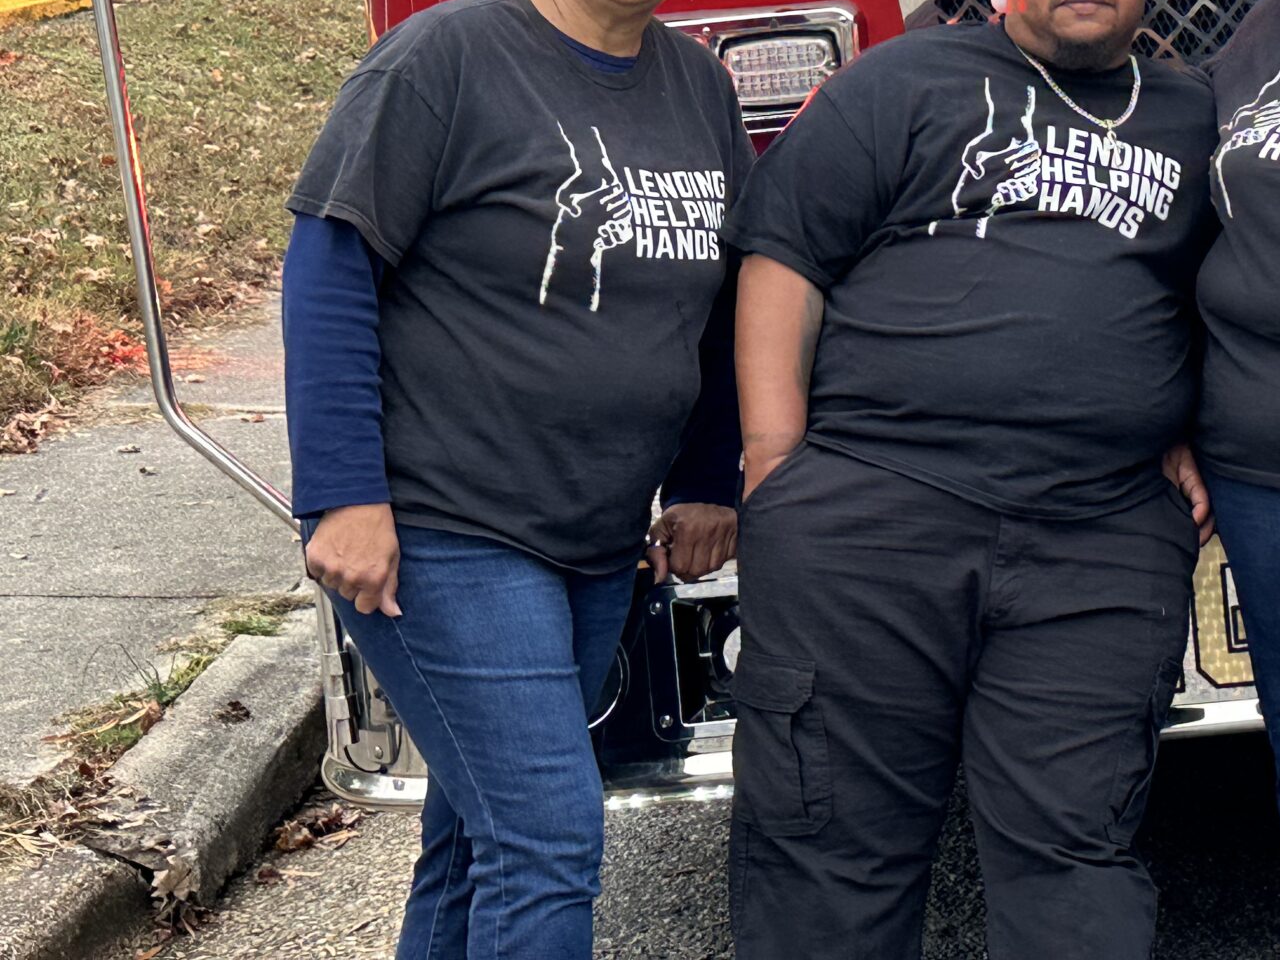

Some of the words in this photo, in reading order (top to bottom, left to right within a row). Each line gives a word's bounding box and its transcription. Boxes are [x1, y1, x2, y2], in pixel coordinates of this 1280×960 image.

[1045, 125, 1183, 190] LENDING
[623, 166, 726, 200] LENDING
[1041, 155, 1175, 222] HELPING
[629, 197, 726, 230] HELPING
[1037, 181, 1145, 240] HANDS
[635, 228, 720, 261] HANDS
